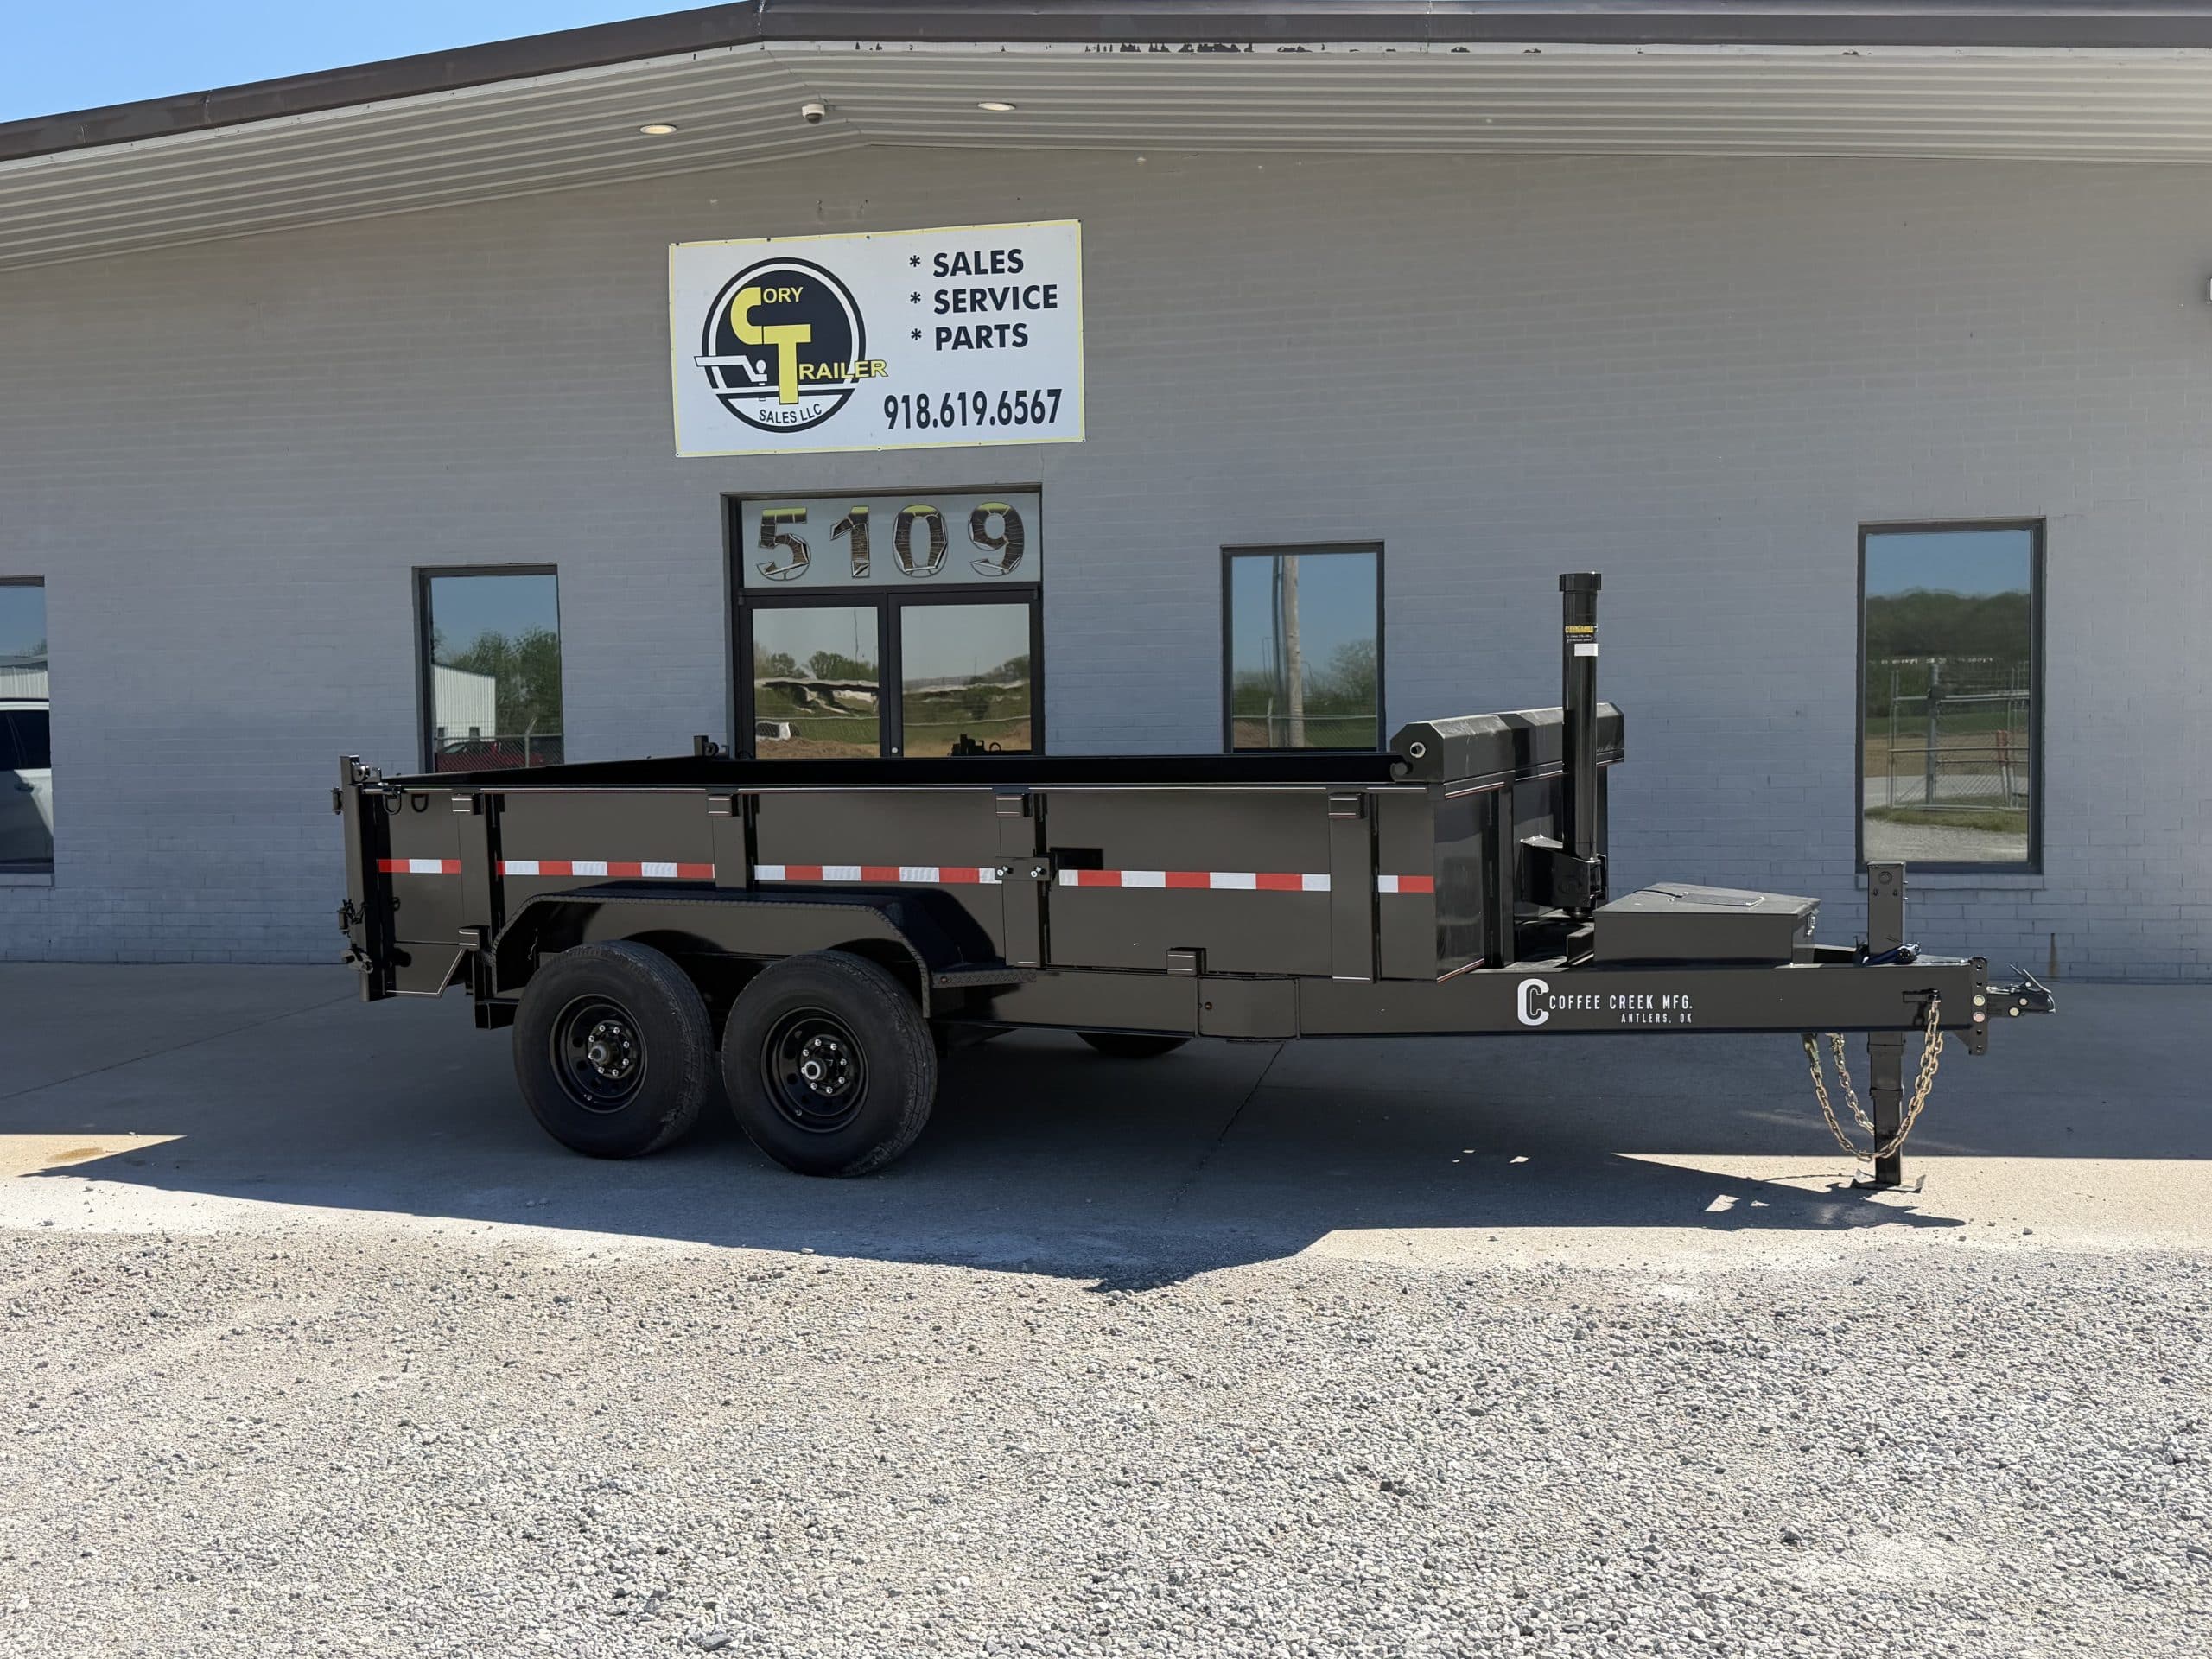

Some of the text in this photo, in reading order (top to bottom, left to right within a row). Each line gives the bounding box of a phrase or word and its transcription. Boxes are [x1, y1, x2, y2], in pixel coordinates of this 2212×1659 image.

[933, 249, 1024, 277] SALES
[934, 284, 1058, 315] SERVICE
[936, 323, 1028, 351] PARTS
[759, 403, 822, 423] SALES LLC
[884, 389, 1062, 429] 918.619.6567
[756, 501, 1025, 582] 5109
[1549, 995, 1694, 1009] COFFEE CREEK MFG.
[1680, 1013, 1692, 1023] OK
